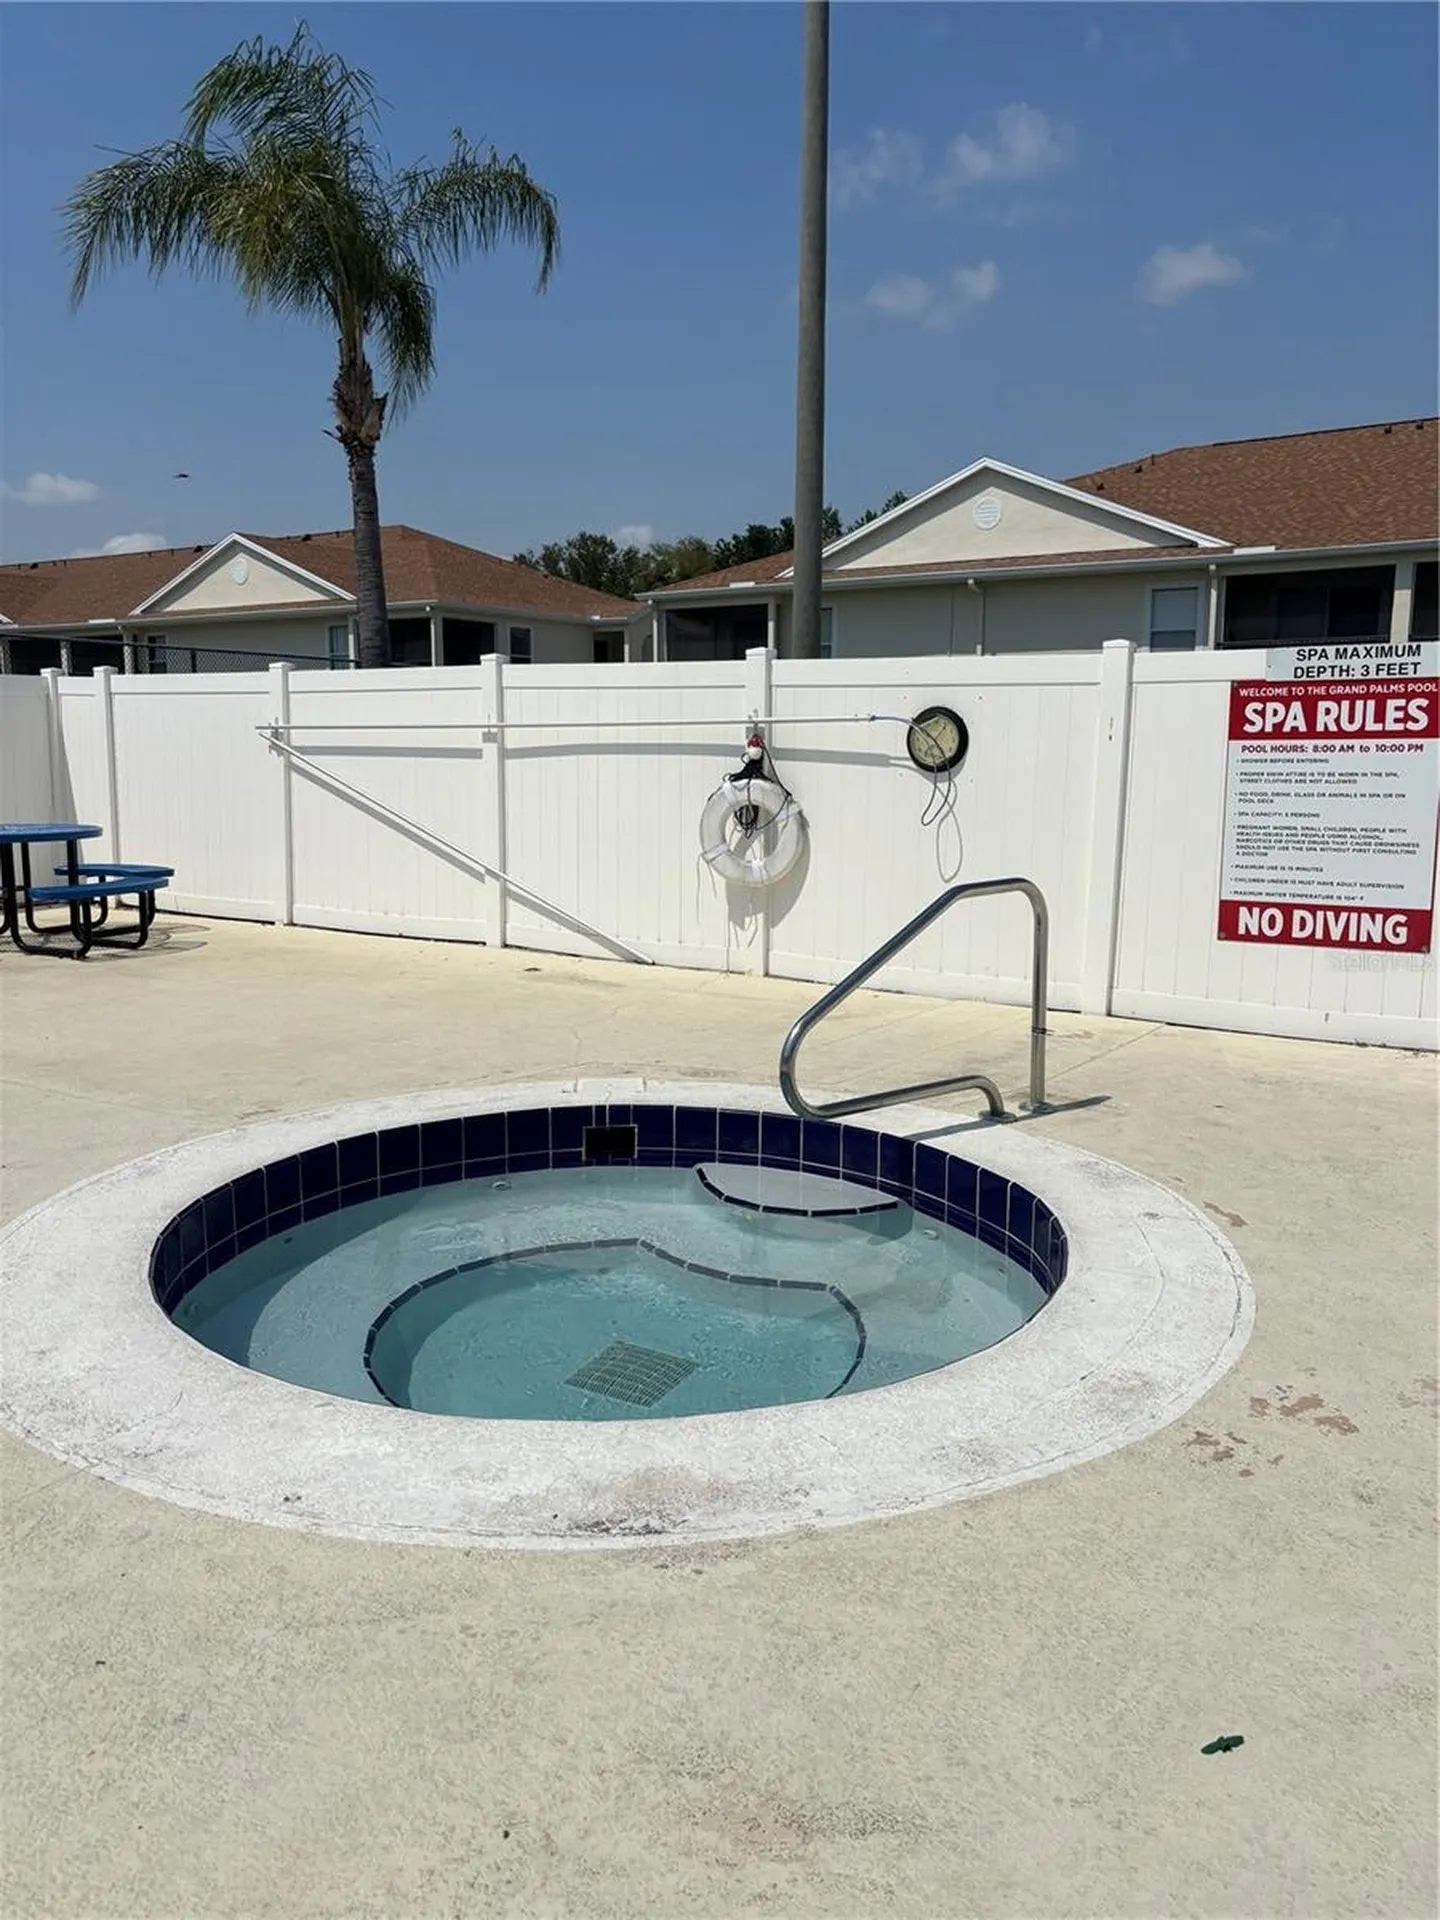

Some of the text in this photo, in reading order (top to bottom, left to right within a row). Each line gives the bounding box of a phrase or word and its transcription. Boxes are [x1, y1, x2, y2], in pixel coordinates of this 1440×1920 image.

[1296, 644, 1422, 662] SPA MAXIMUM
[1294, 662, 1421, 679] DEPTH: 3 FEET
[1239, 683, 1438, 697] WELCOME TO THE GRAND PALMS POOL
[1243, 698, 1430, 733] SPA RULES
[1241, 743, 1424, 753] POOL HOURS: 8:00 AM to 10:00 PM
[1288, 892, 1334, 900] TEMPERATURE
[1237, 906, 1409, 945] NO DIVING
